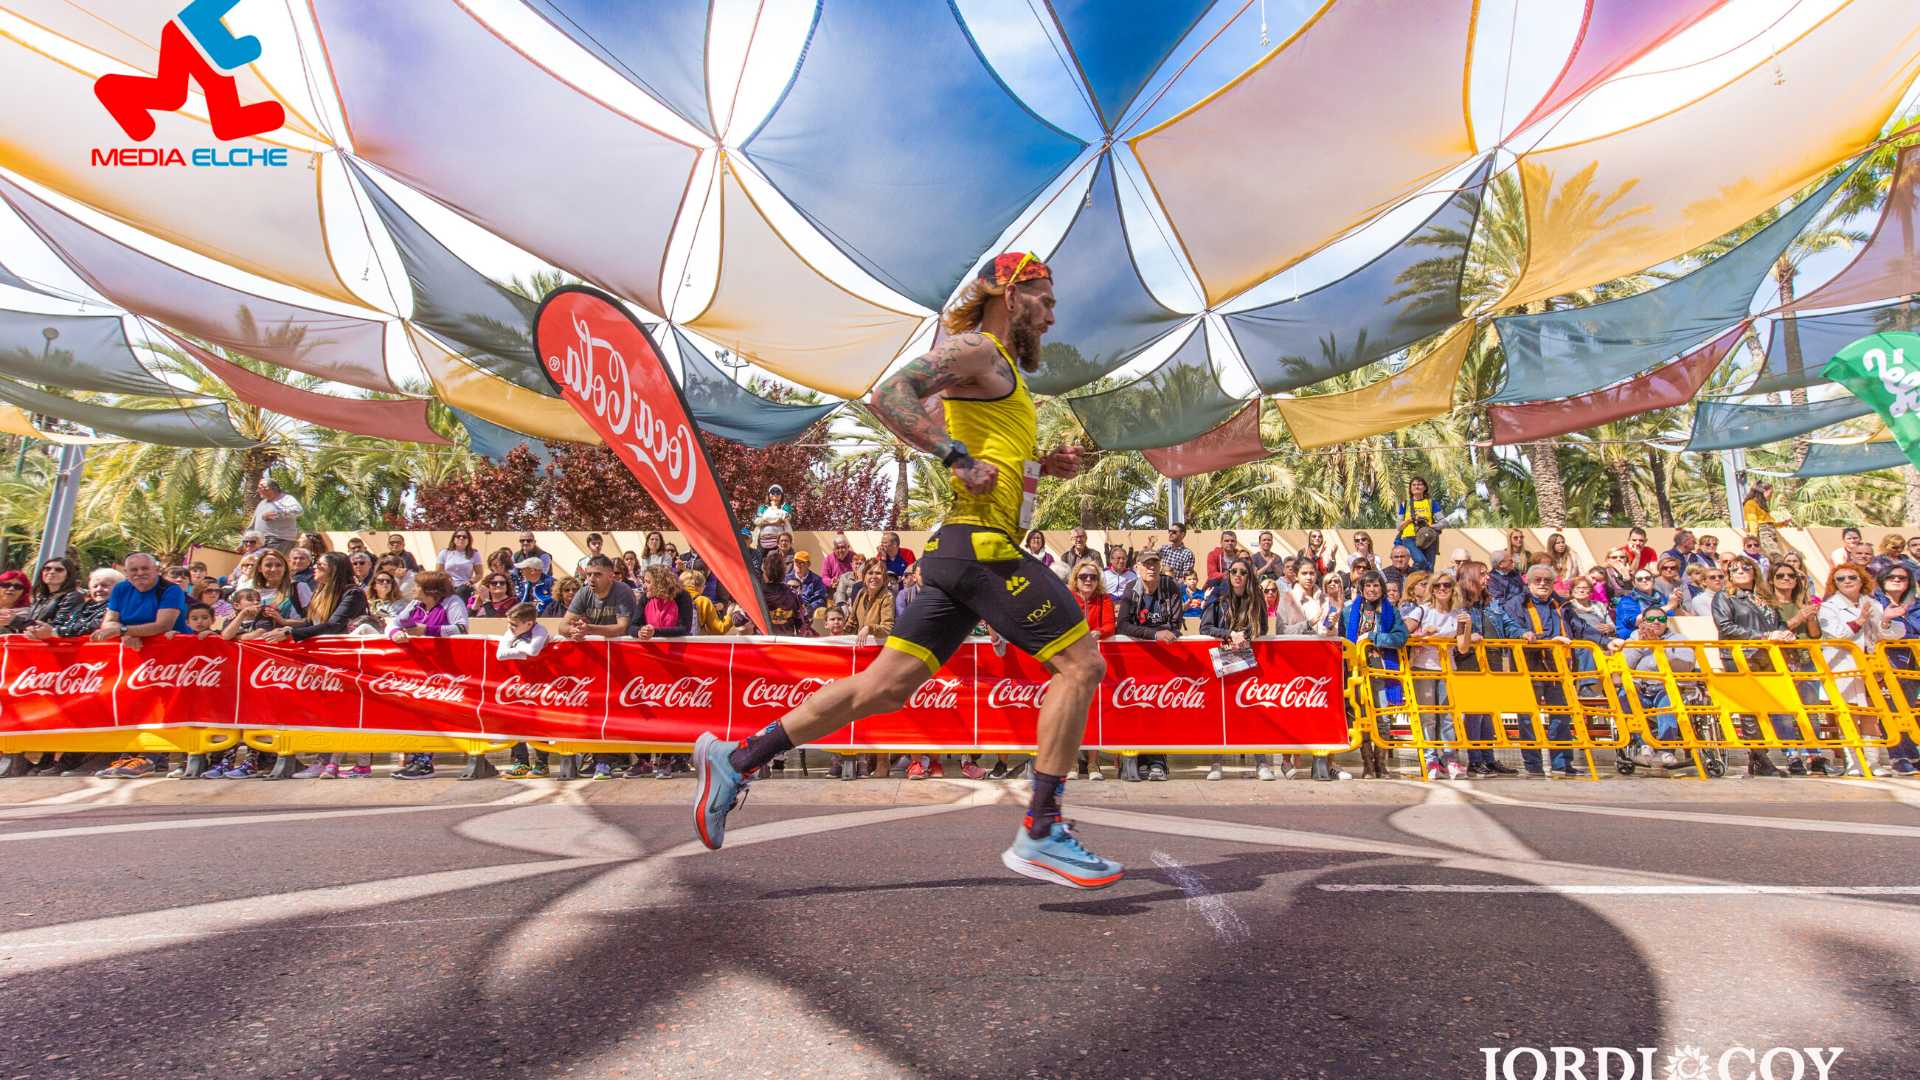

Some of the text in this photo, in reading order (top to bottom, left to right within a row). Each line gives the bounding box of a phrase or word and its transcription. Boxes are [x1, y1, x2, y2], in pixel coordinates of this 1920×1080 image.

[8, 661, 108, 697] Coca-Cola
[127, 655, 227, 689] Coca-Cola
[250, 658, 345, 692] Coca-Cola
[495, 674, 595, 706] Coca-Cola
[619, 676, 716, 708] Coca-Cola
[1112, 677, 1209, 708] Coca-Cola
[1235, 676, 1332, 708] Coca-Cola
